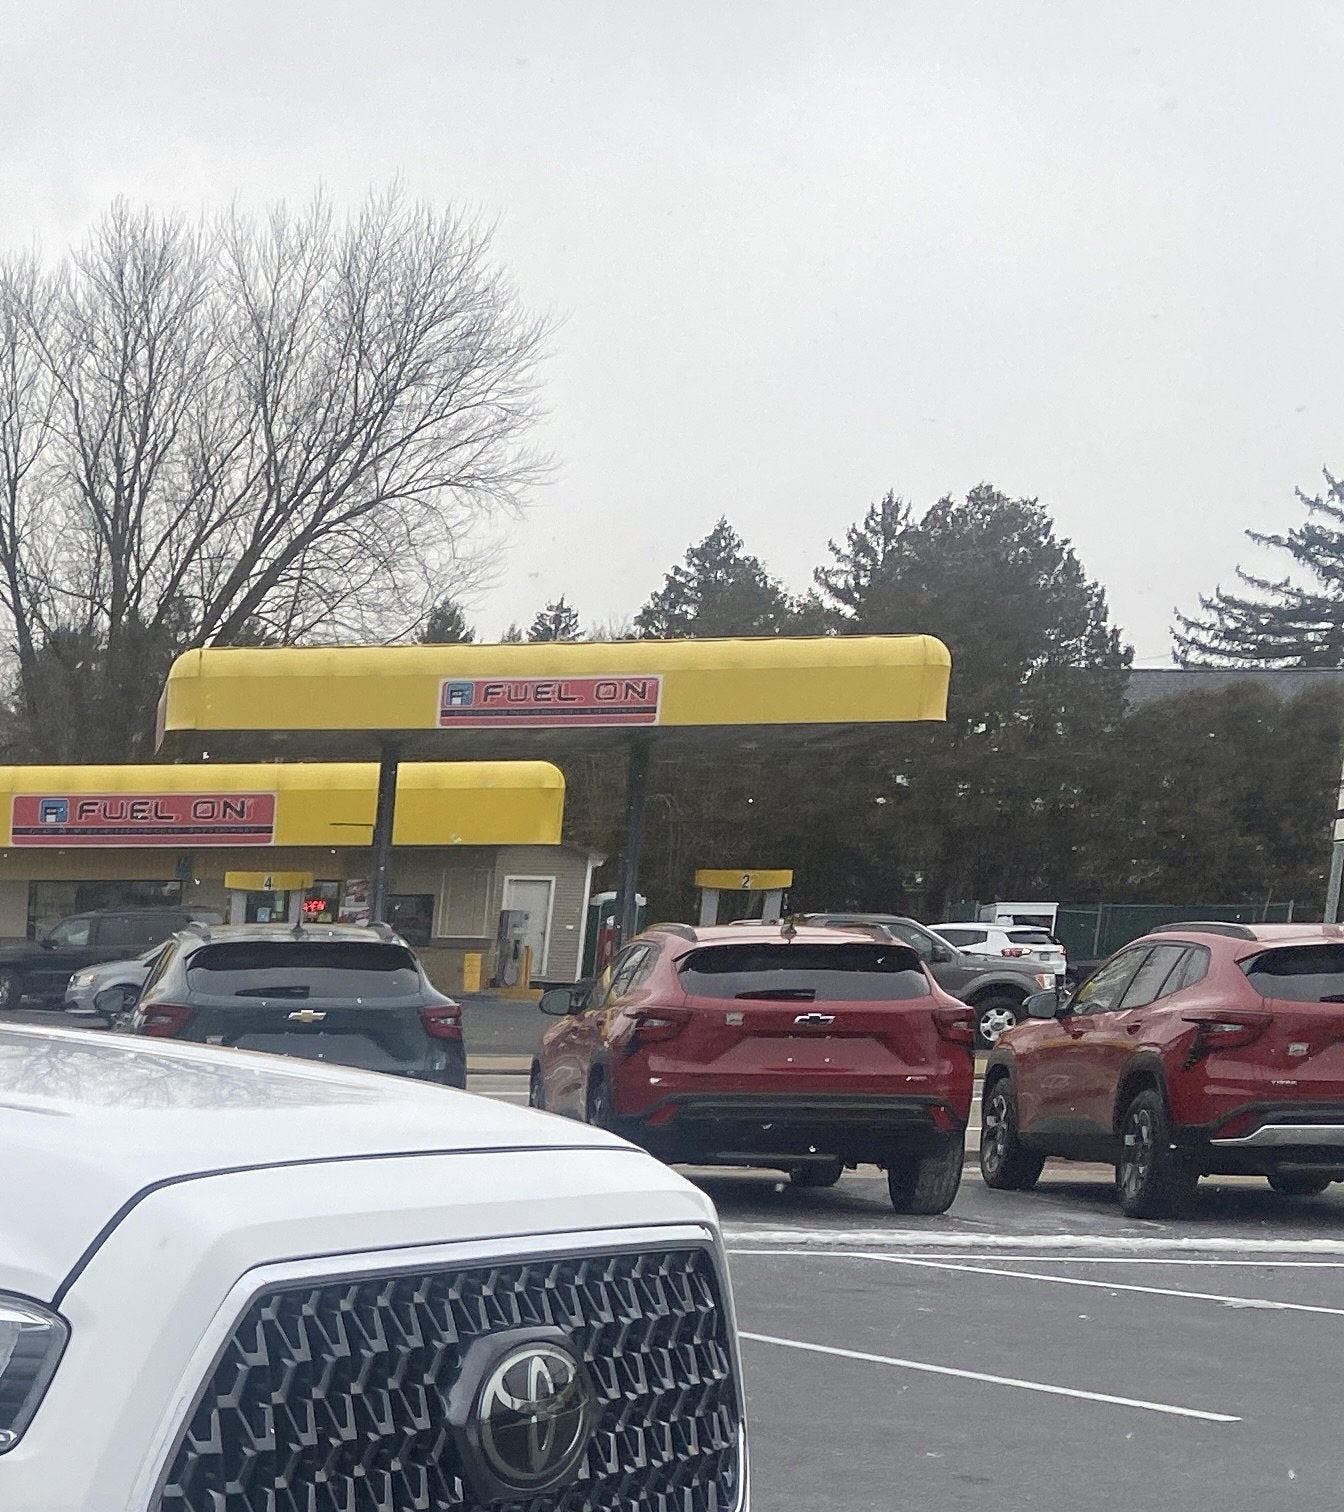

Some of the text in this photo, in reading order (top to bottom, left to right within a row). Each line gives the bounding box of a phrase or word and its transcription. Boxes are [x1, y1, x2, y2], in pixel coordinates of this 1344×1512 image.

[482, 683, 578, 703] FUEL
[595, 681, 647, 701] ON
[77, 800, 175, 821] FUEL
[192, 799, 246, 820] ON
[264, 876, 272, 889] 4
[742, 874, 750, 888] 2
